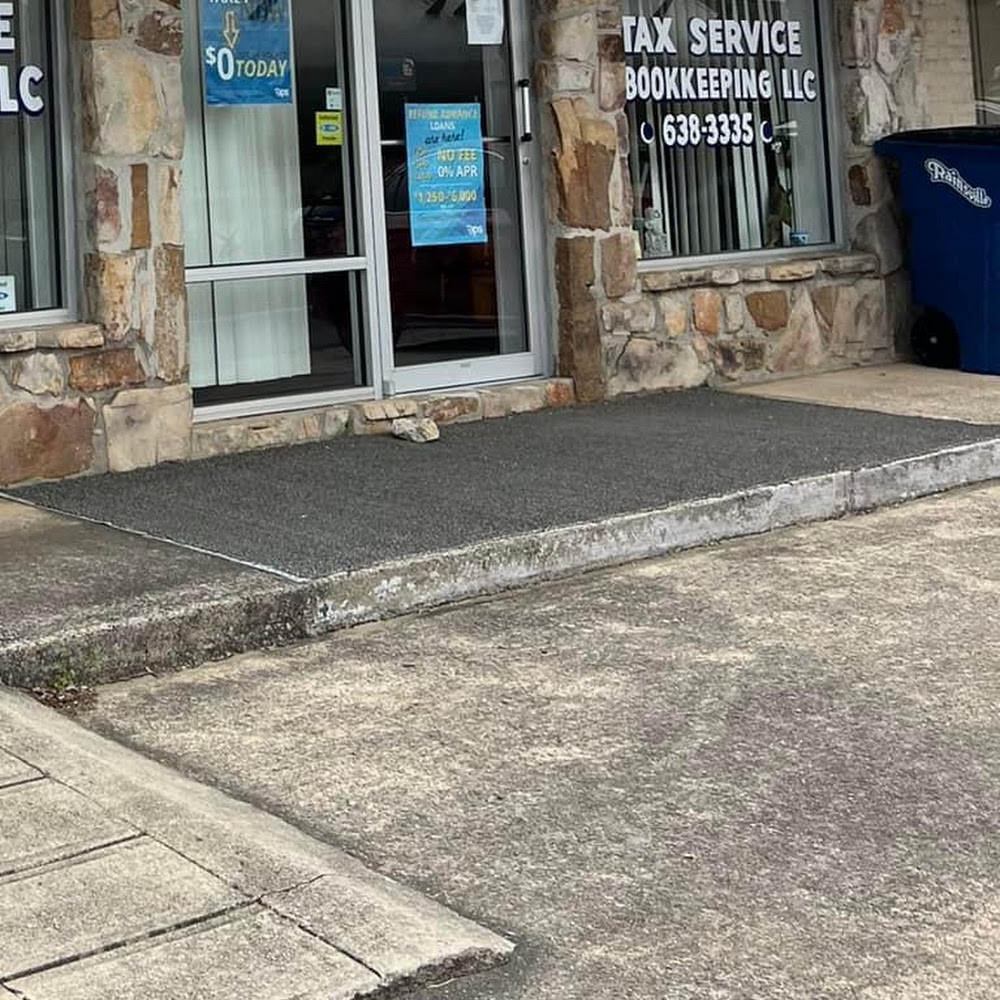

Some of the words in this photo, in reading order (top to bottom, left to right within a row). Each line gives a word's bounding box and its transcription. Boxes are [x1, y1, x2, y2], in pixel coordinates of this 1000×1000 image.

[621, 15, 677, 55] TAX
[689, 17, 803, 56] SERVICE
[205, 45, 235, 81] $0
[235, 59, 288, 78] TODAY
[625, 65, 772, 101] BOOKKEEPING
[781, 68, 818, 102] LLC
[662, 112, 754, 147] 638-3335
[437, 149, 455, 161] NO
[457, 149, 477, 160] FEE
[437, 165, 454, 178] 0%
[455, 165, 478, 178] APR
